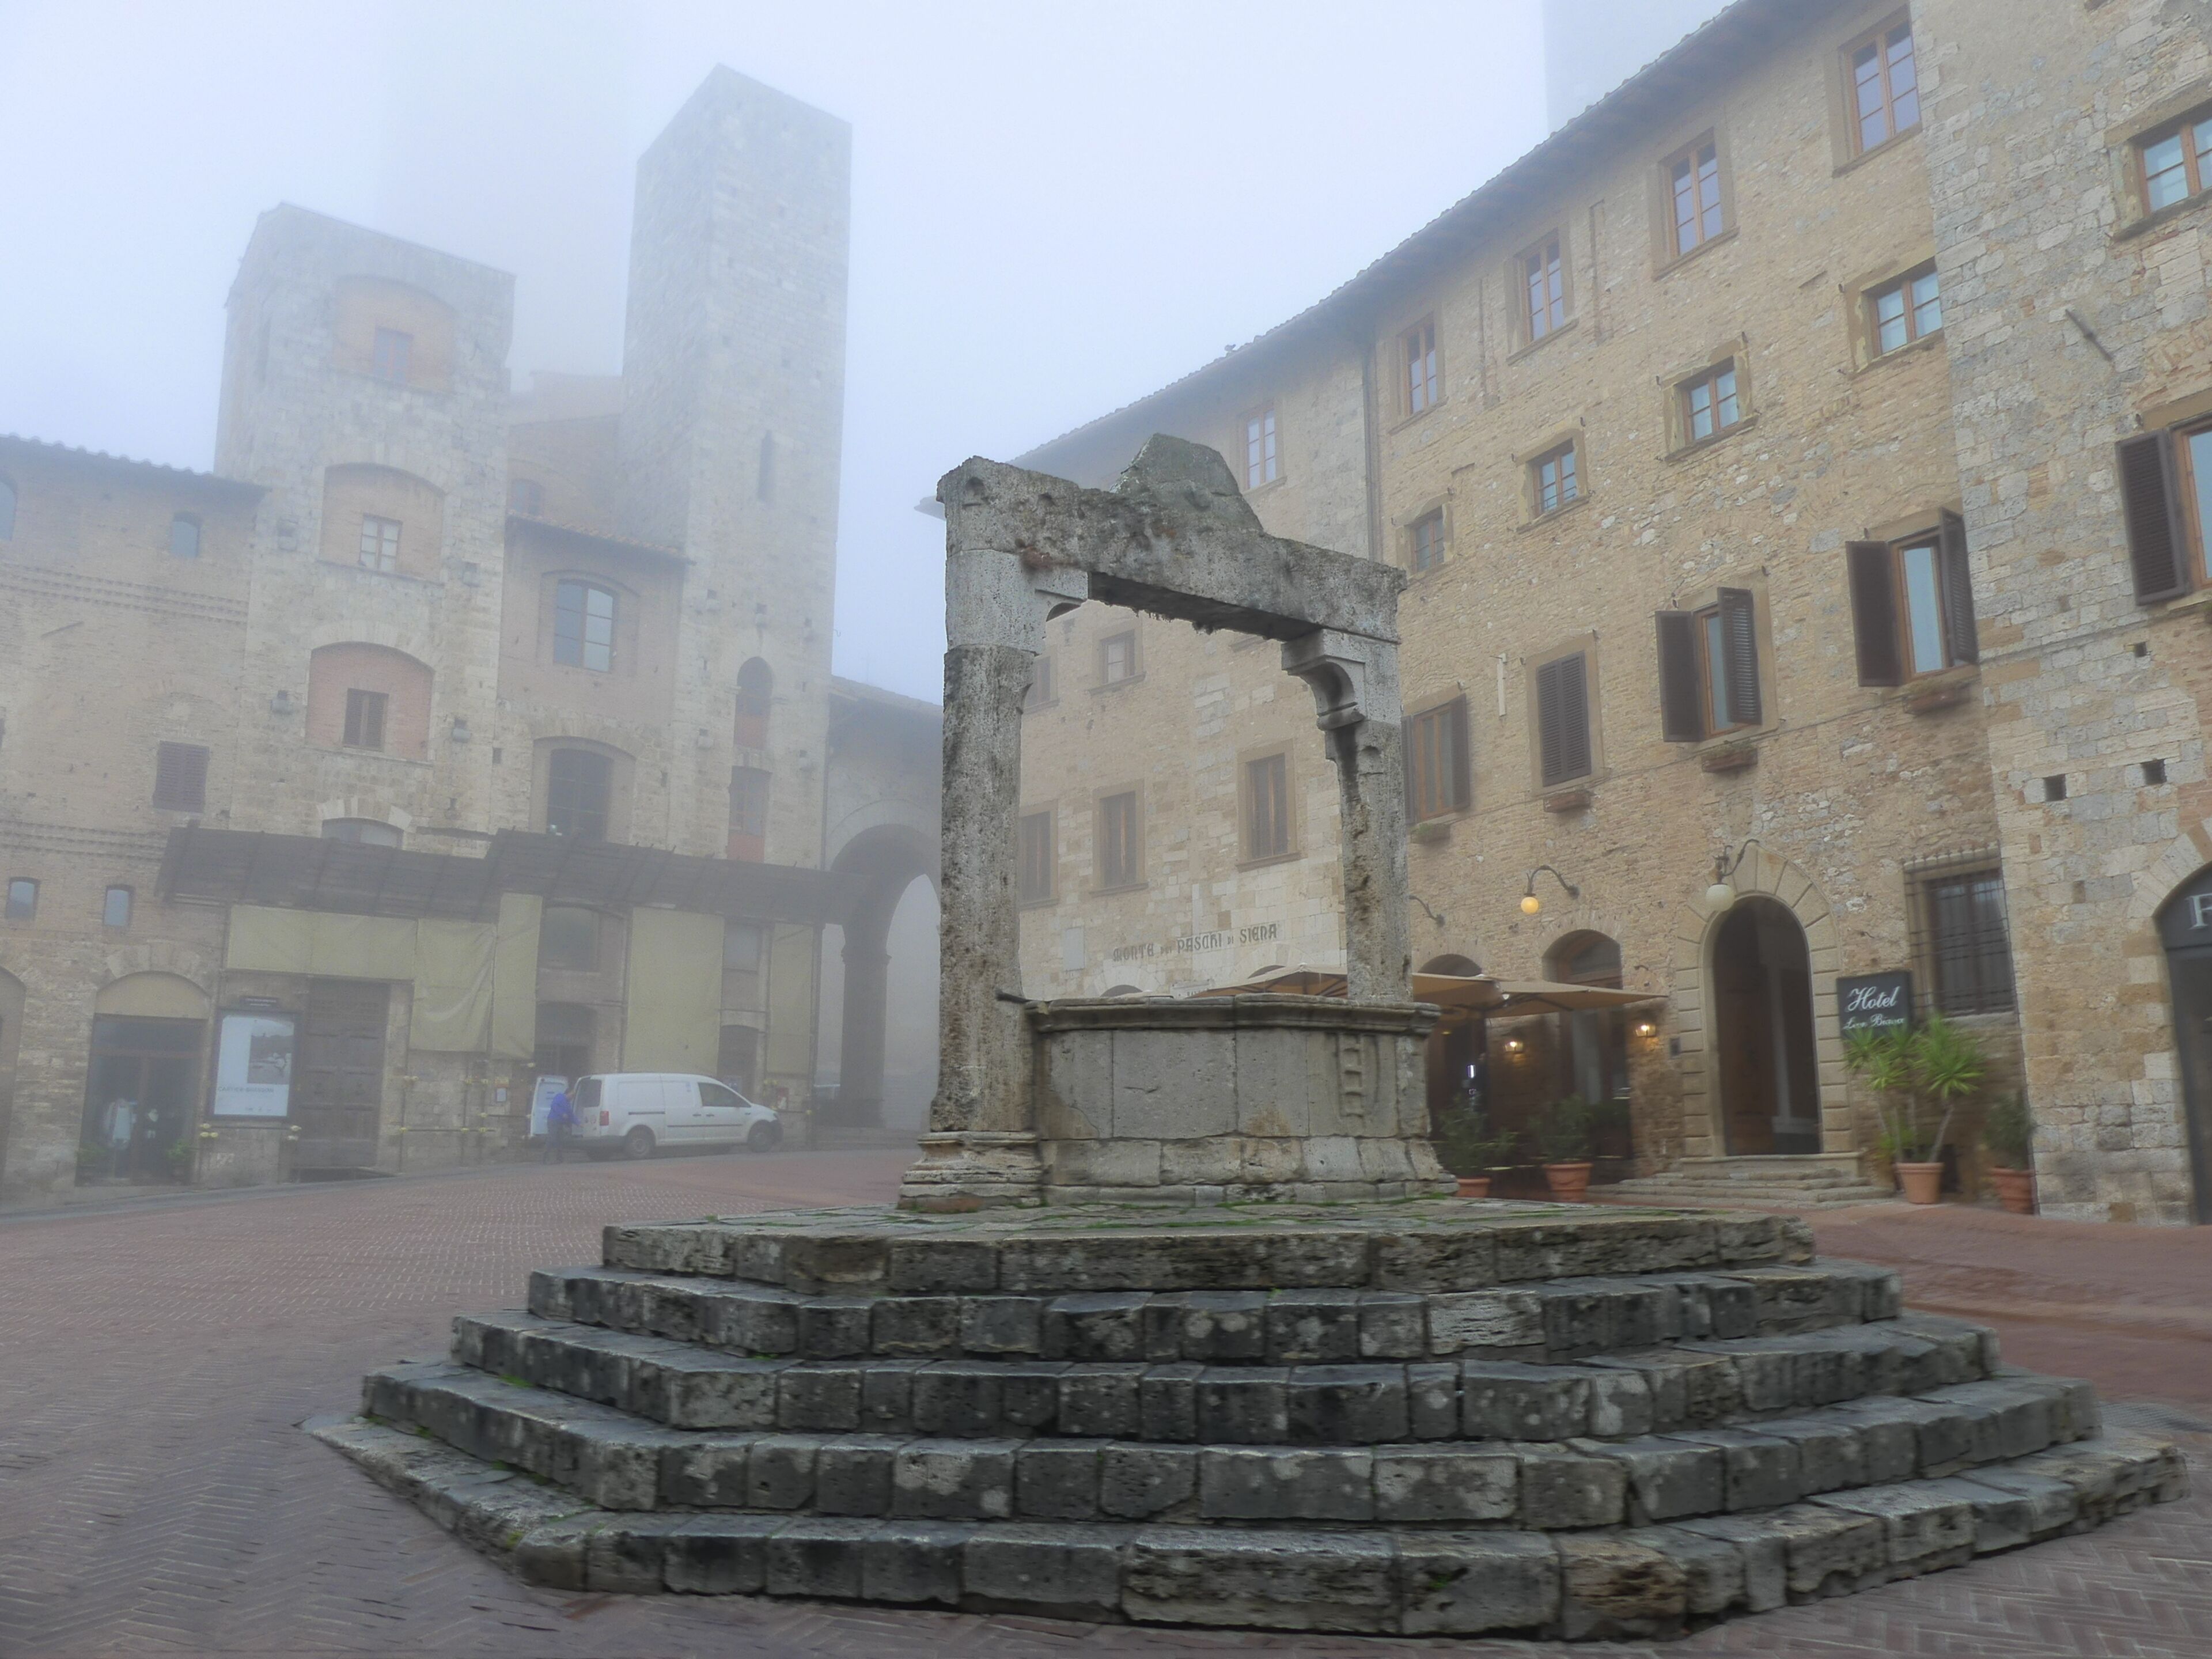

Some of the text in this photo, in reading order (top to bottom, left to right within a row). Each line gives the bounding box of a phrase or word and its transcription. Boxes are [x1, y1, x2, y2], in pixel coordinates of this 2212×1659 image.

[1113, 942, 1154, 961] MONTE
[1177, 933, 1222, 953] PASCHI
[1240, 923, 1277, 944] SIENA
[1845, 986, 1900, 1012] Hotel
